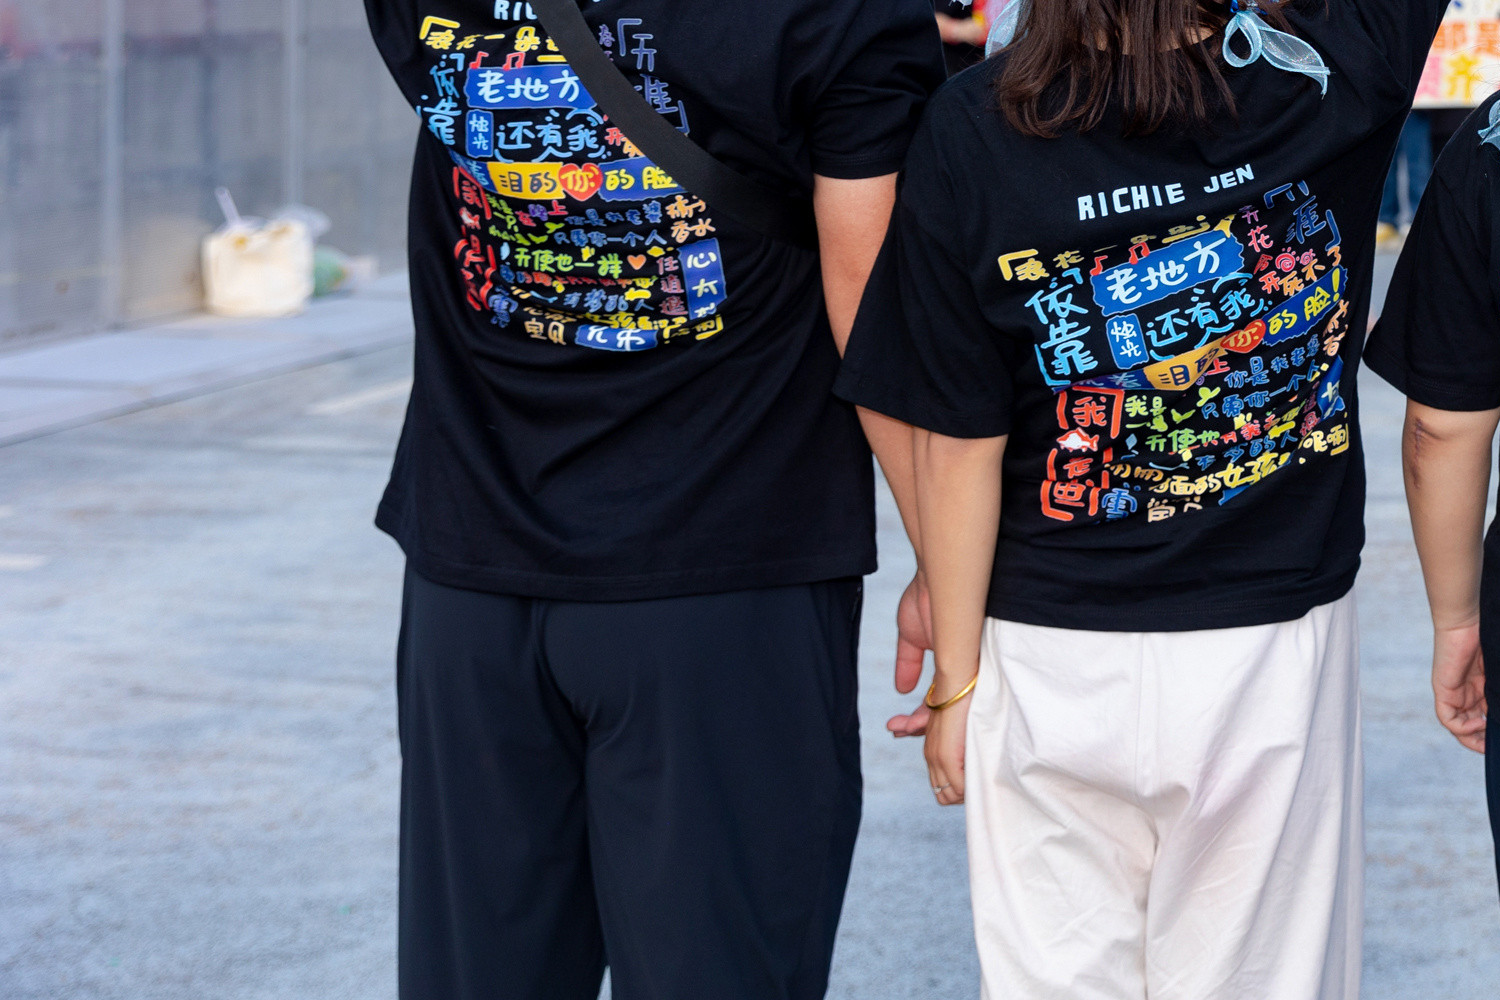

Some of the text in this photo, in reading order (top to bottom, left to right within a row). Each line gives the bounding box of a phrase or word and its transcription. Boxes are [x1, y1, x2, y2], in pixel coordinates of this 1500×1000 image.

[475, 69, 580, 104] 老地方
[496, 116, 600, 151] 还有我
[1077, 163, 1255, 221] RICHIE JEN
[1105, 237, 1227, 305] 老地方
[1146, 284, 1256, 348] 还有我
